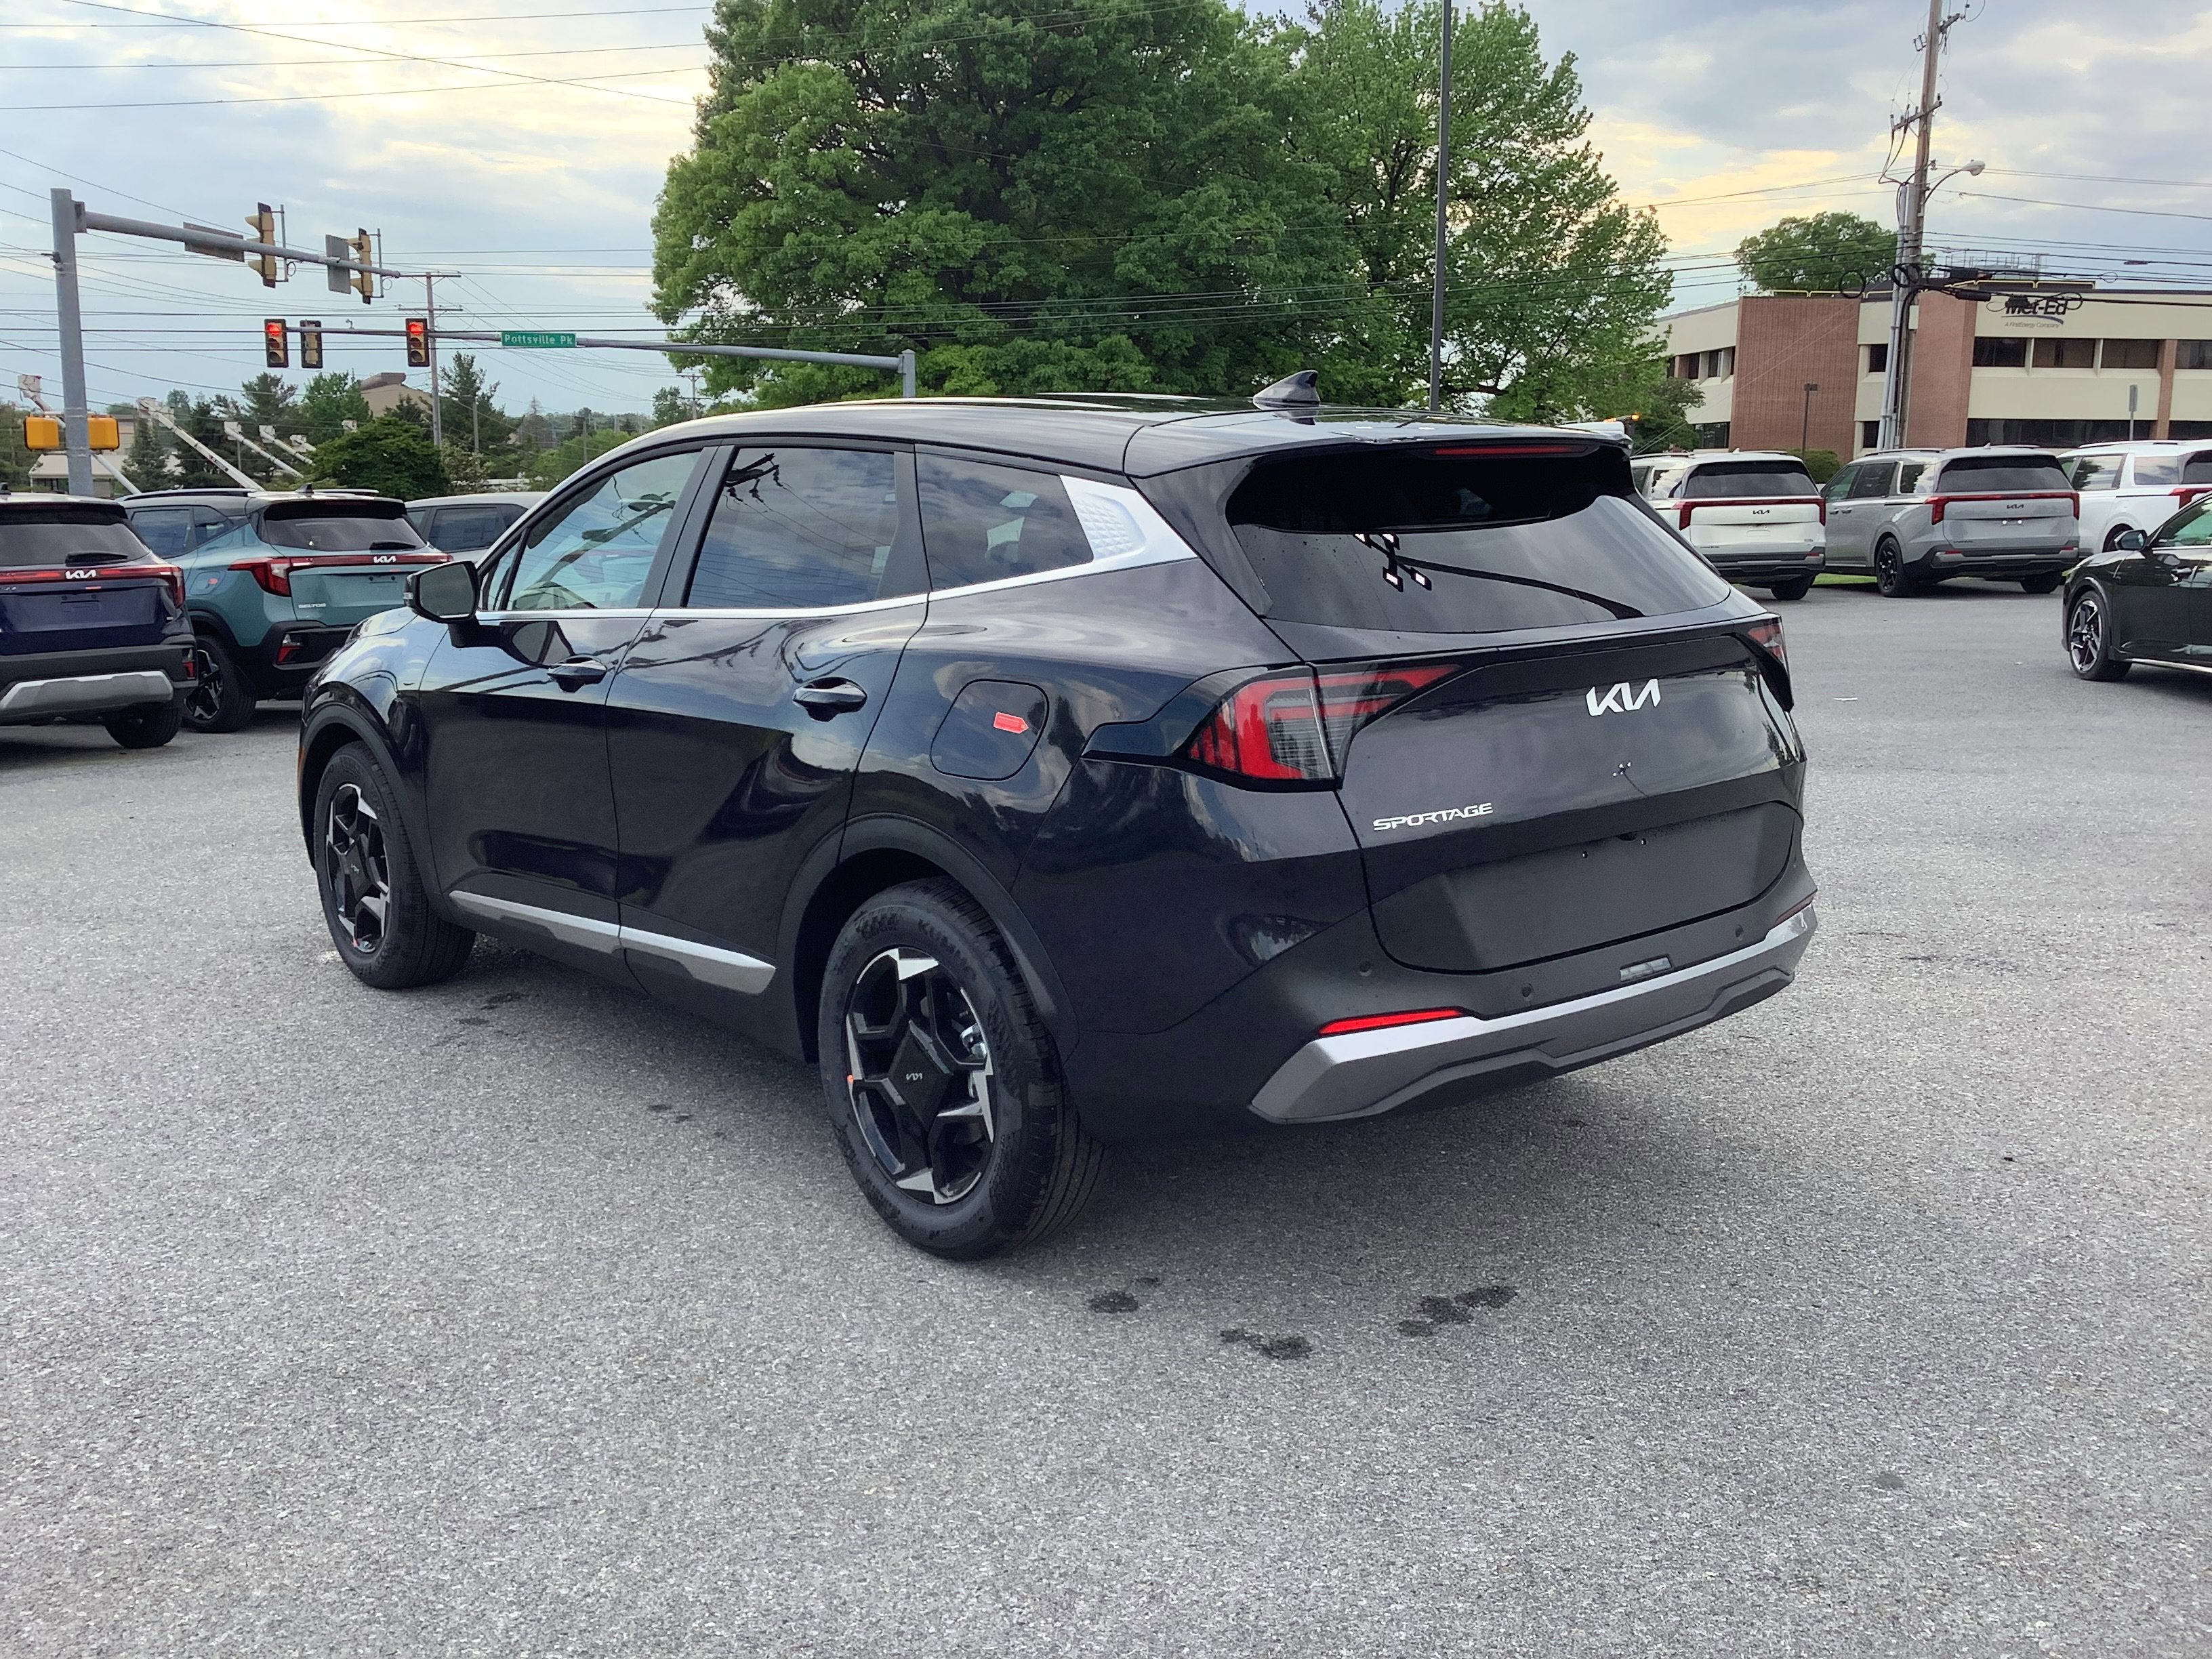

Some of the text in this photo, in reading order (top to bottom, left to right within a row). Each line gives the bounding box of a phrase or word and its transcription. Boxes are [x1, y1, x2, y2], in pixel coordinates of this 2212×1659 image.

[504, 334, 573, 344] Pottsville Pk
[65, 569, 96, 579] KIA
[1586, 678, 1661, 716] KIA
[1373, 802, 1493, 832] SPORTAGE
